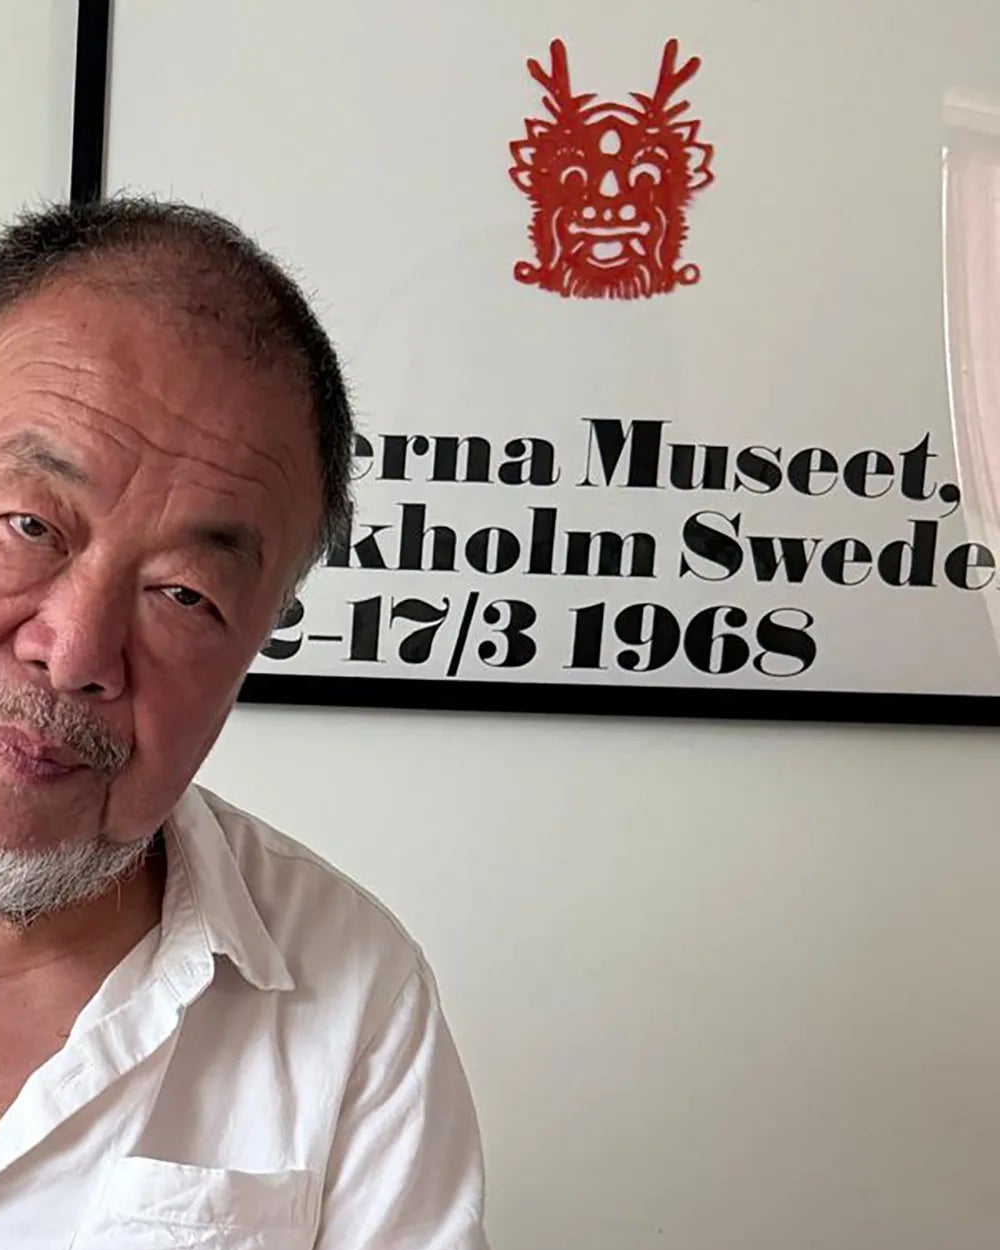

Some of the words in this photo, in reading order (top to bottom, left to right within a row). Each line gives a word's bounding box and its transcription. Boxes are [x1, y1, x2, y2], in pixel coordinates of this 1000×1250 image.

[575, 417, 961, 518] Museet,
[679, 510, 1000, 591] Swede
[562, 601, 817, 678] 1968
